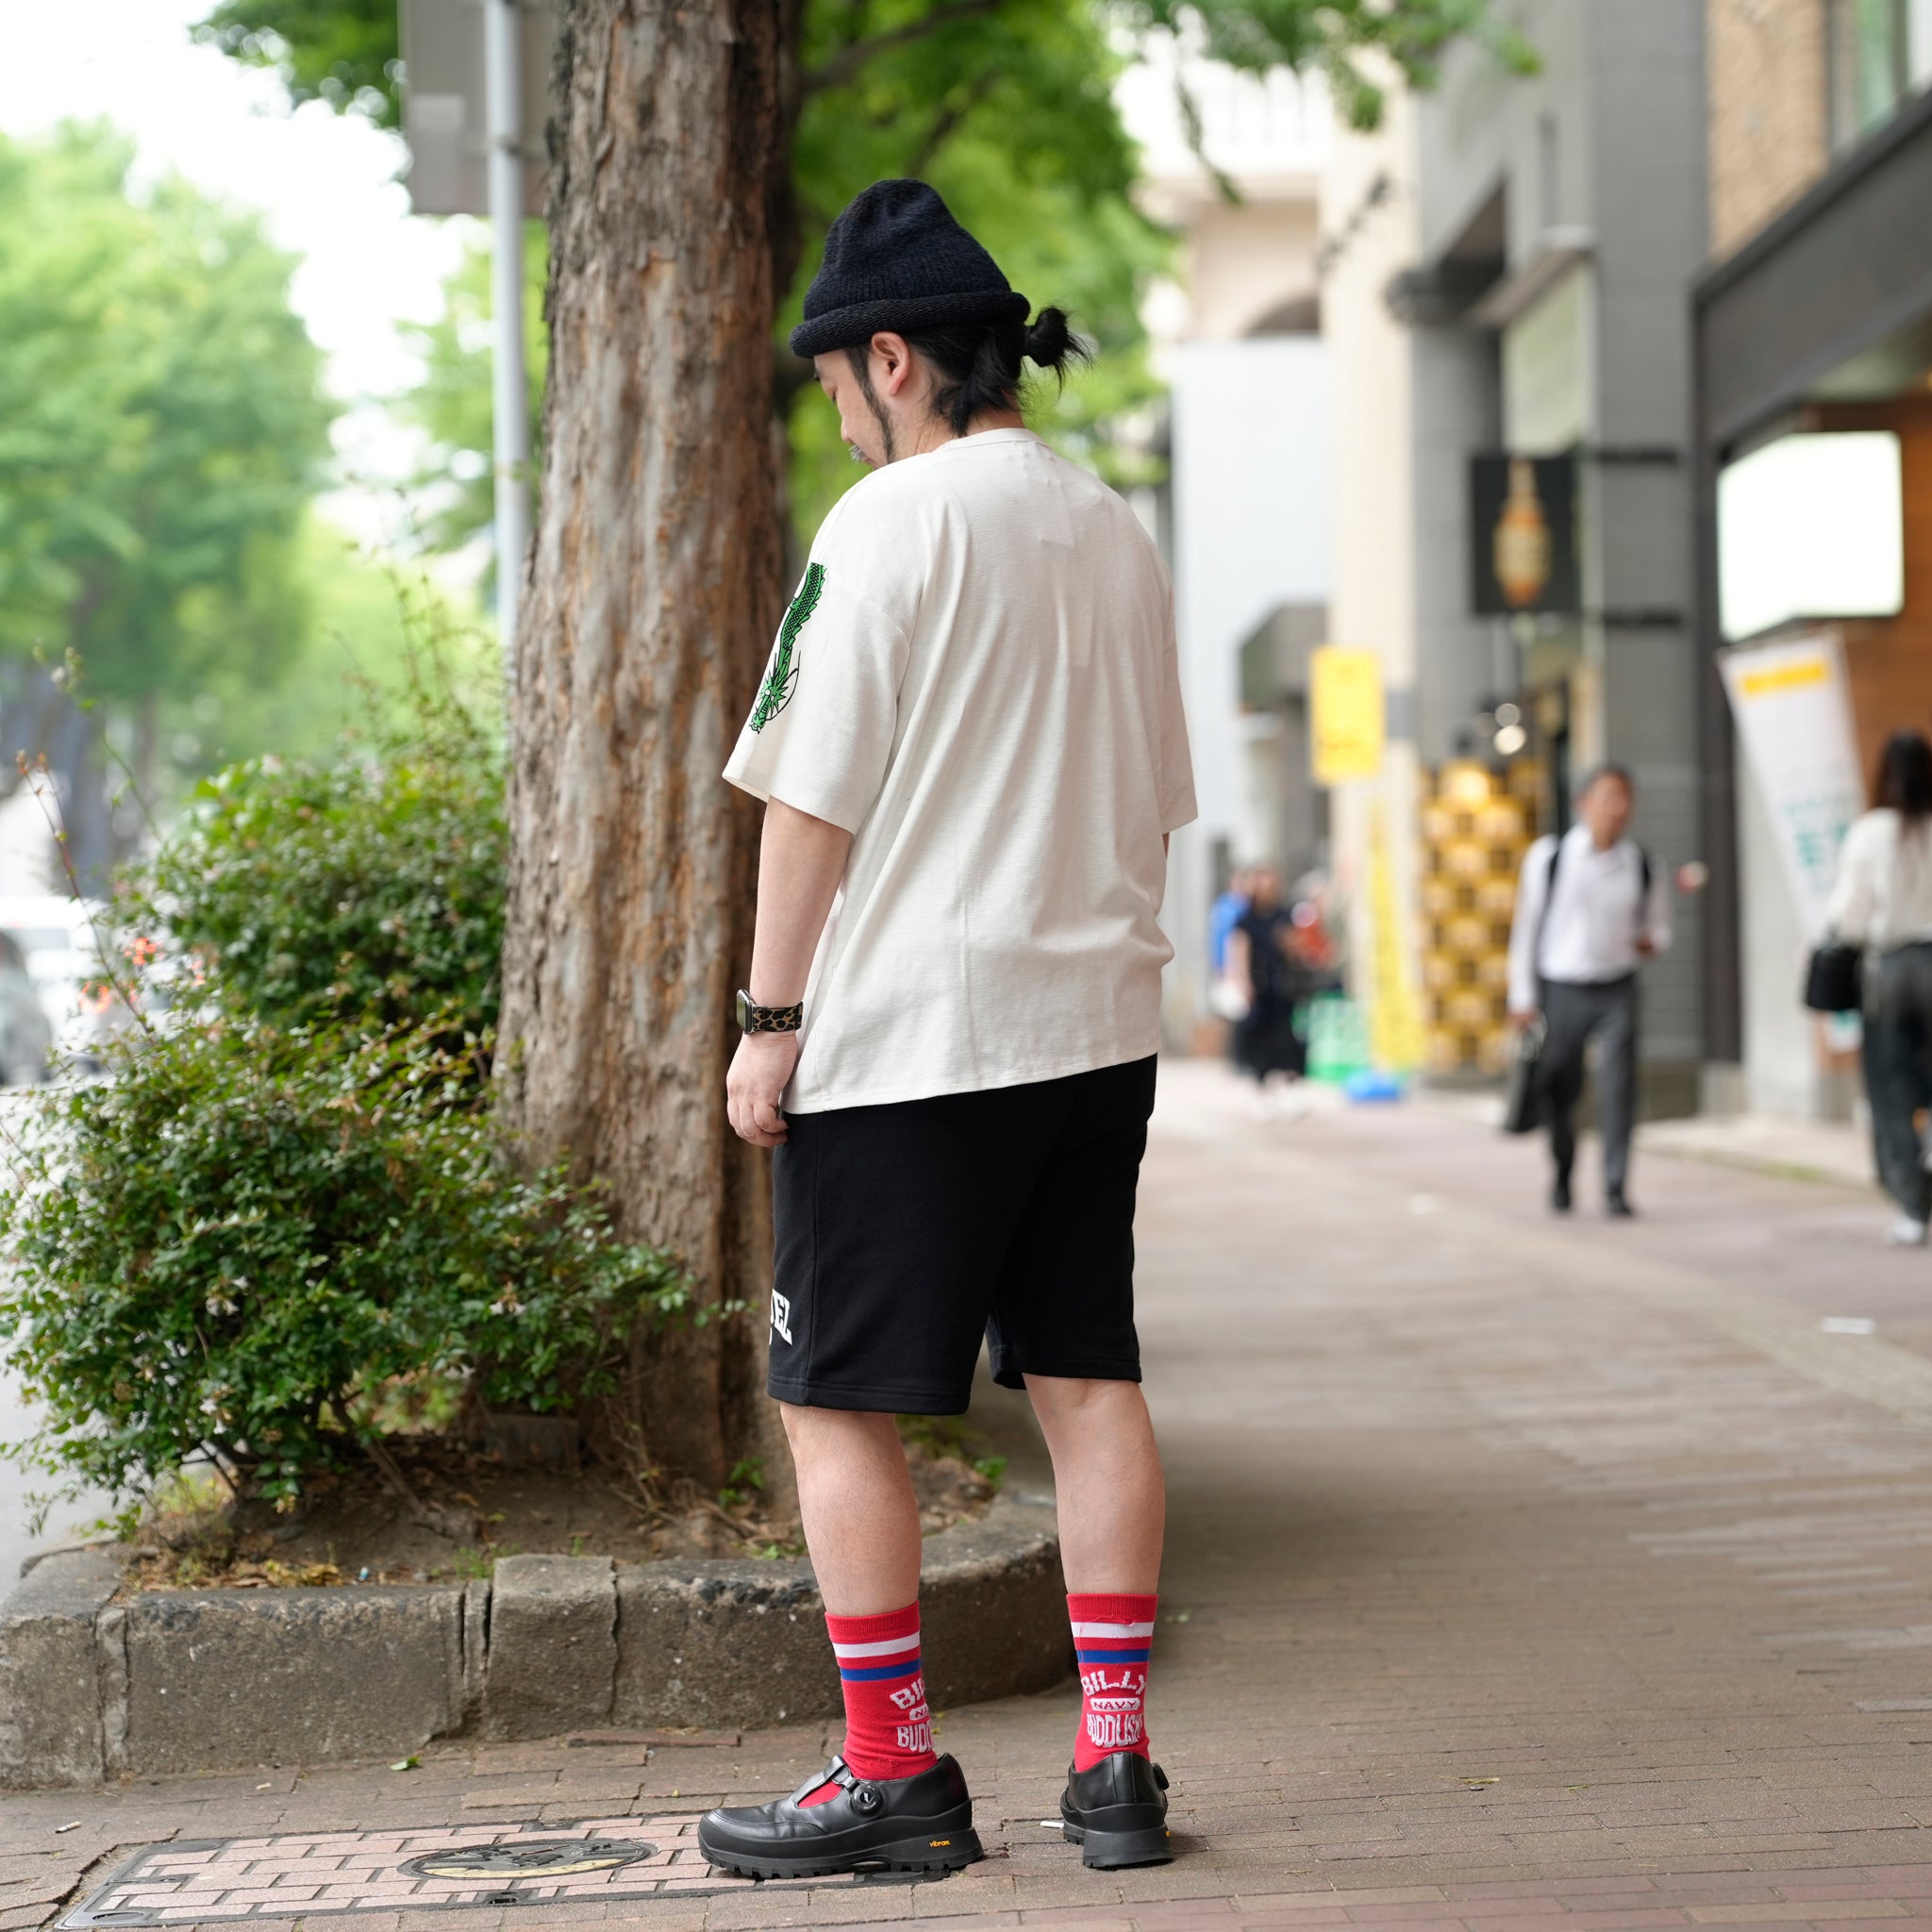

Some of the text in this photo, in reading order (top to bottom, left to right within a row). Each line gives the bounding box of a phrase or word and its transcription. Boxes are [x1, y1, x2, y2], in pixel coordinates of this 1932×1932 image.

[769, 1288, 792, 1345] EL
[1081, 1670, 1147, 1696] BILLY
[1092, 1700, 1138, 1710] NAVY
